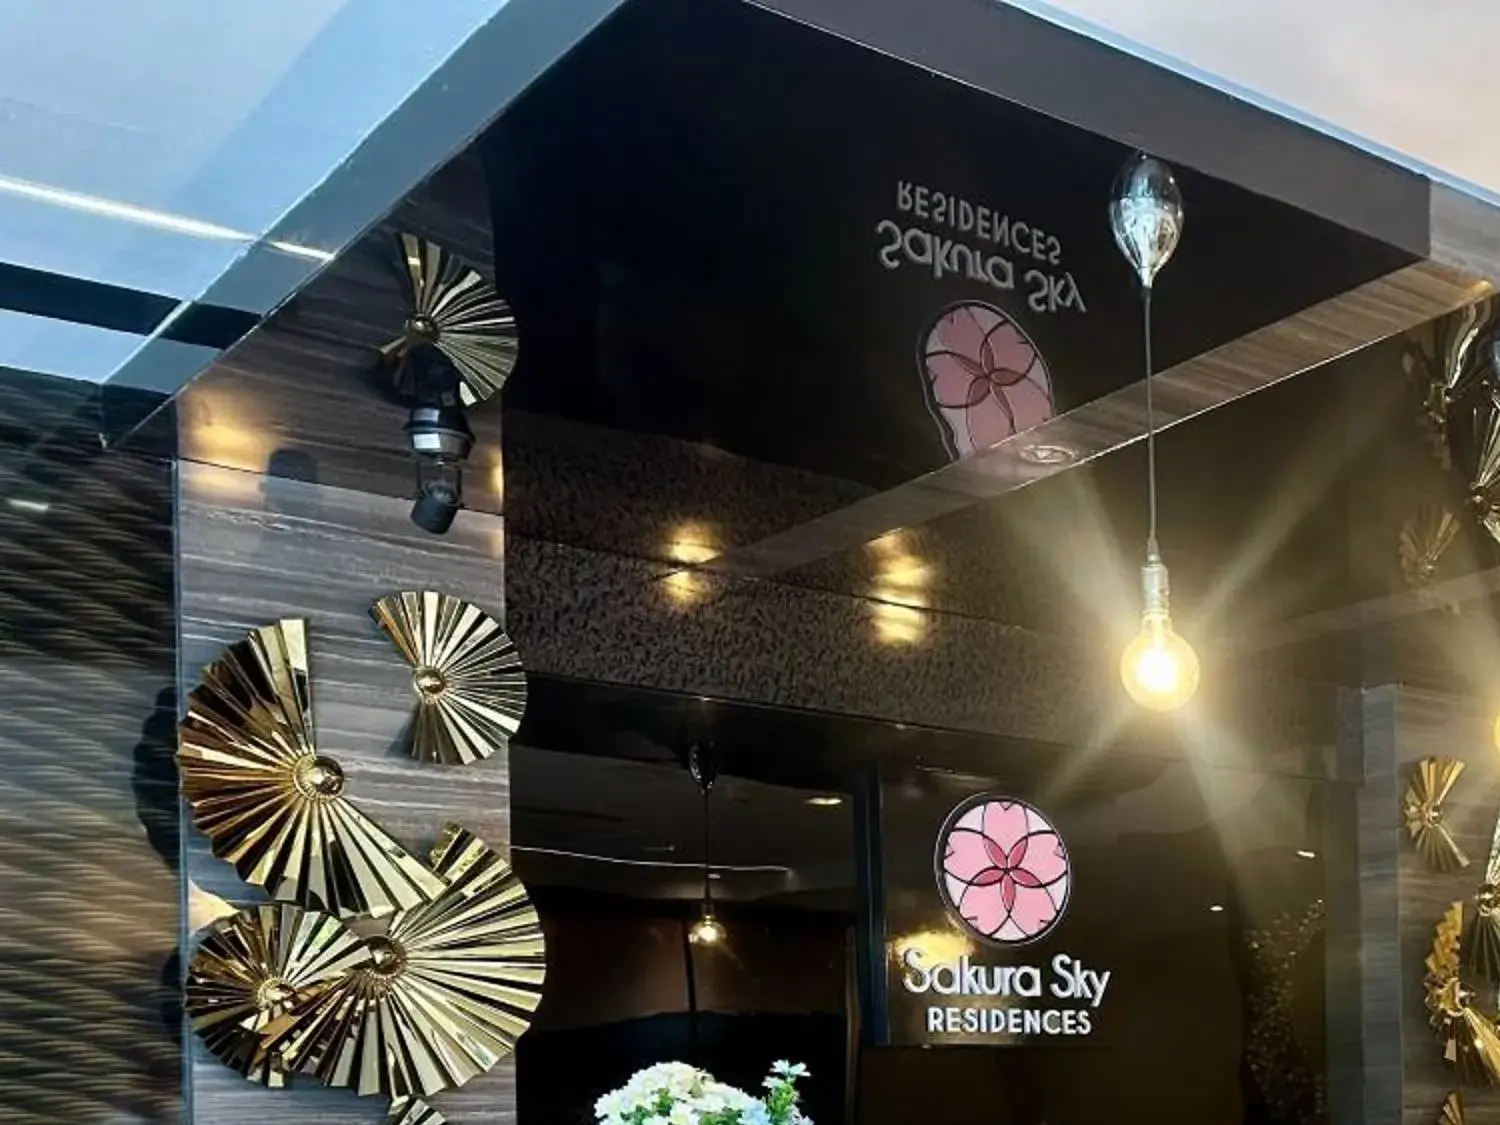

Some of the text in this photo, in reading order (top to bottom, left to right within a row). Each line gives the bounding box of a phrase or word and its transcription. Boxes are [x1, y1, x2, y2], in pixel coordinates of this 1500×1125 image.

[902, 947, 1112, 1008] Sakura Sky
[926, 1006, 1093, 1036] RESIDENCES
